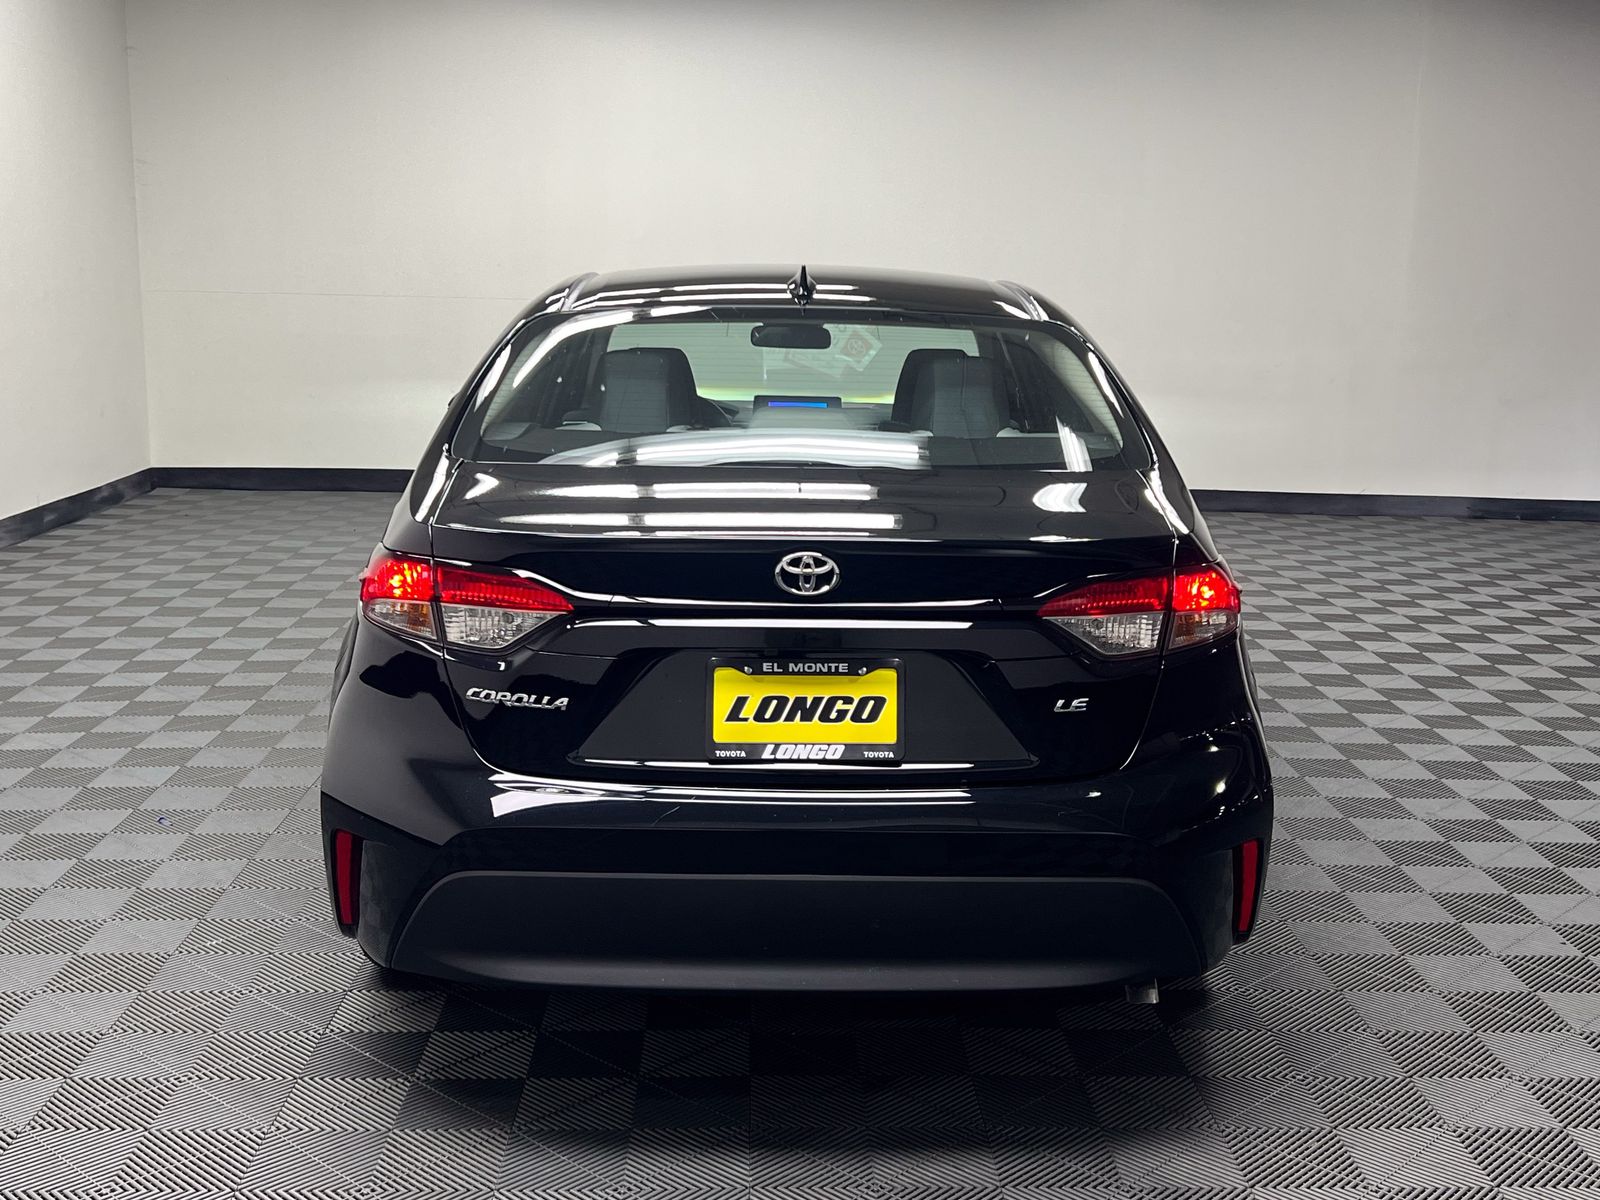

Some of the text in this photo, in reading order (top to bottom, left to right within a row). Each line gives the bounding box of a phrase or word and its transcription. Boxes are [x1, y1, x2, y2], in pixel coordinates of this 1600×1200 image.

[762, 662, 849, 673] EL MONTE
[465, 687, 570, 711] COROLLA
[1053, 697, 1090, 713] LE
[723, 695, 888, 724] LONGO
[715, 750, 747, 758] TOYOTA
[761, 744, 846, 760] LONGO
[863, 751, 895, 759] TOYOTA
